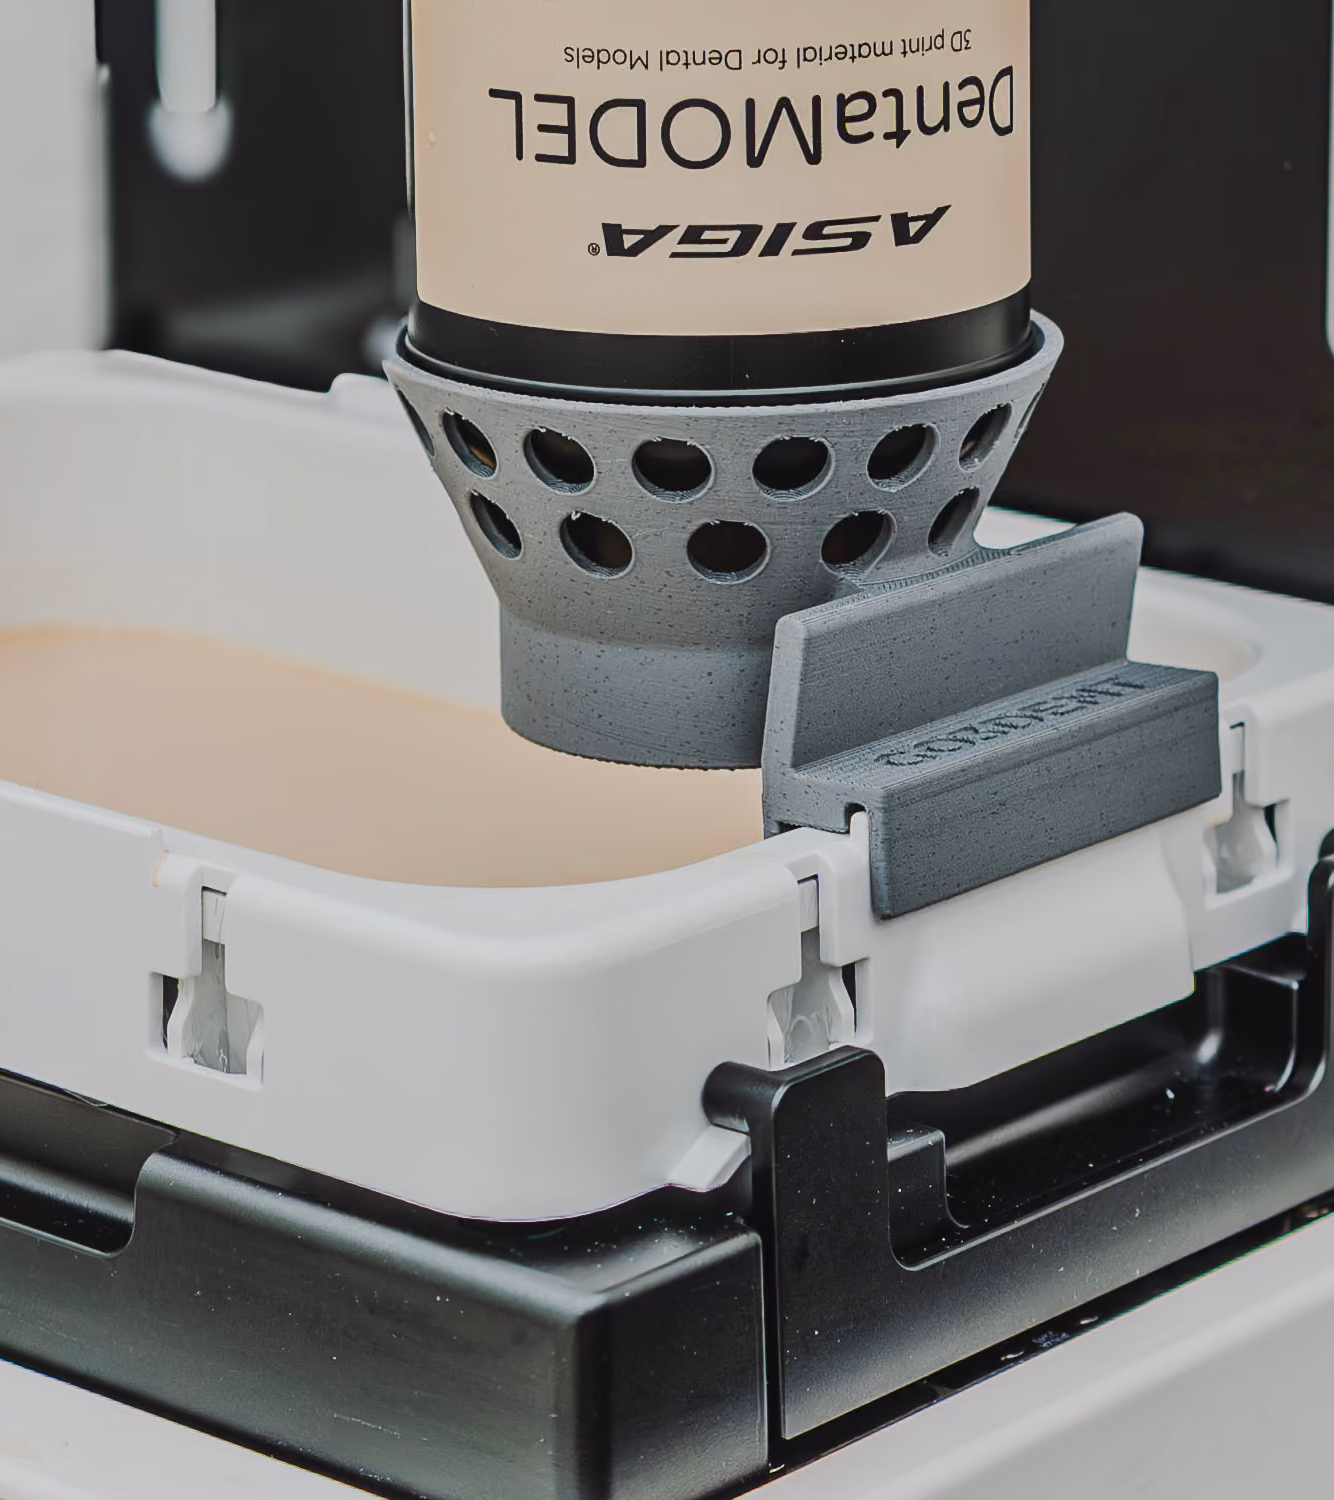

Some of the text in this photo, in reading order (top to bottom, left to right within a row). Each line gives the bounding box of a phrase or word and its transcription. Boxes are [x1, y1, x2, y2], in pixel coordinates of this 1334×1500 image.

[563, 28, 972, 71] 3D print material for Dental Models
[487, 65, 1015, 170] DentaMODEL
